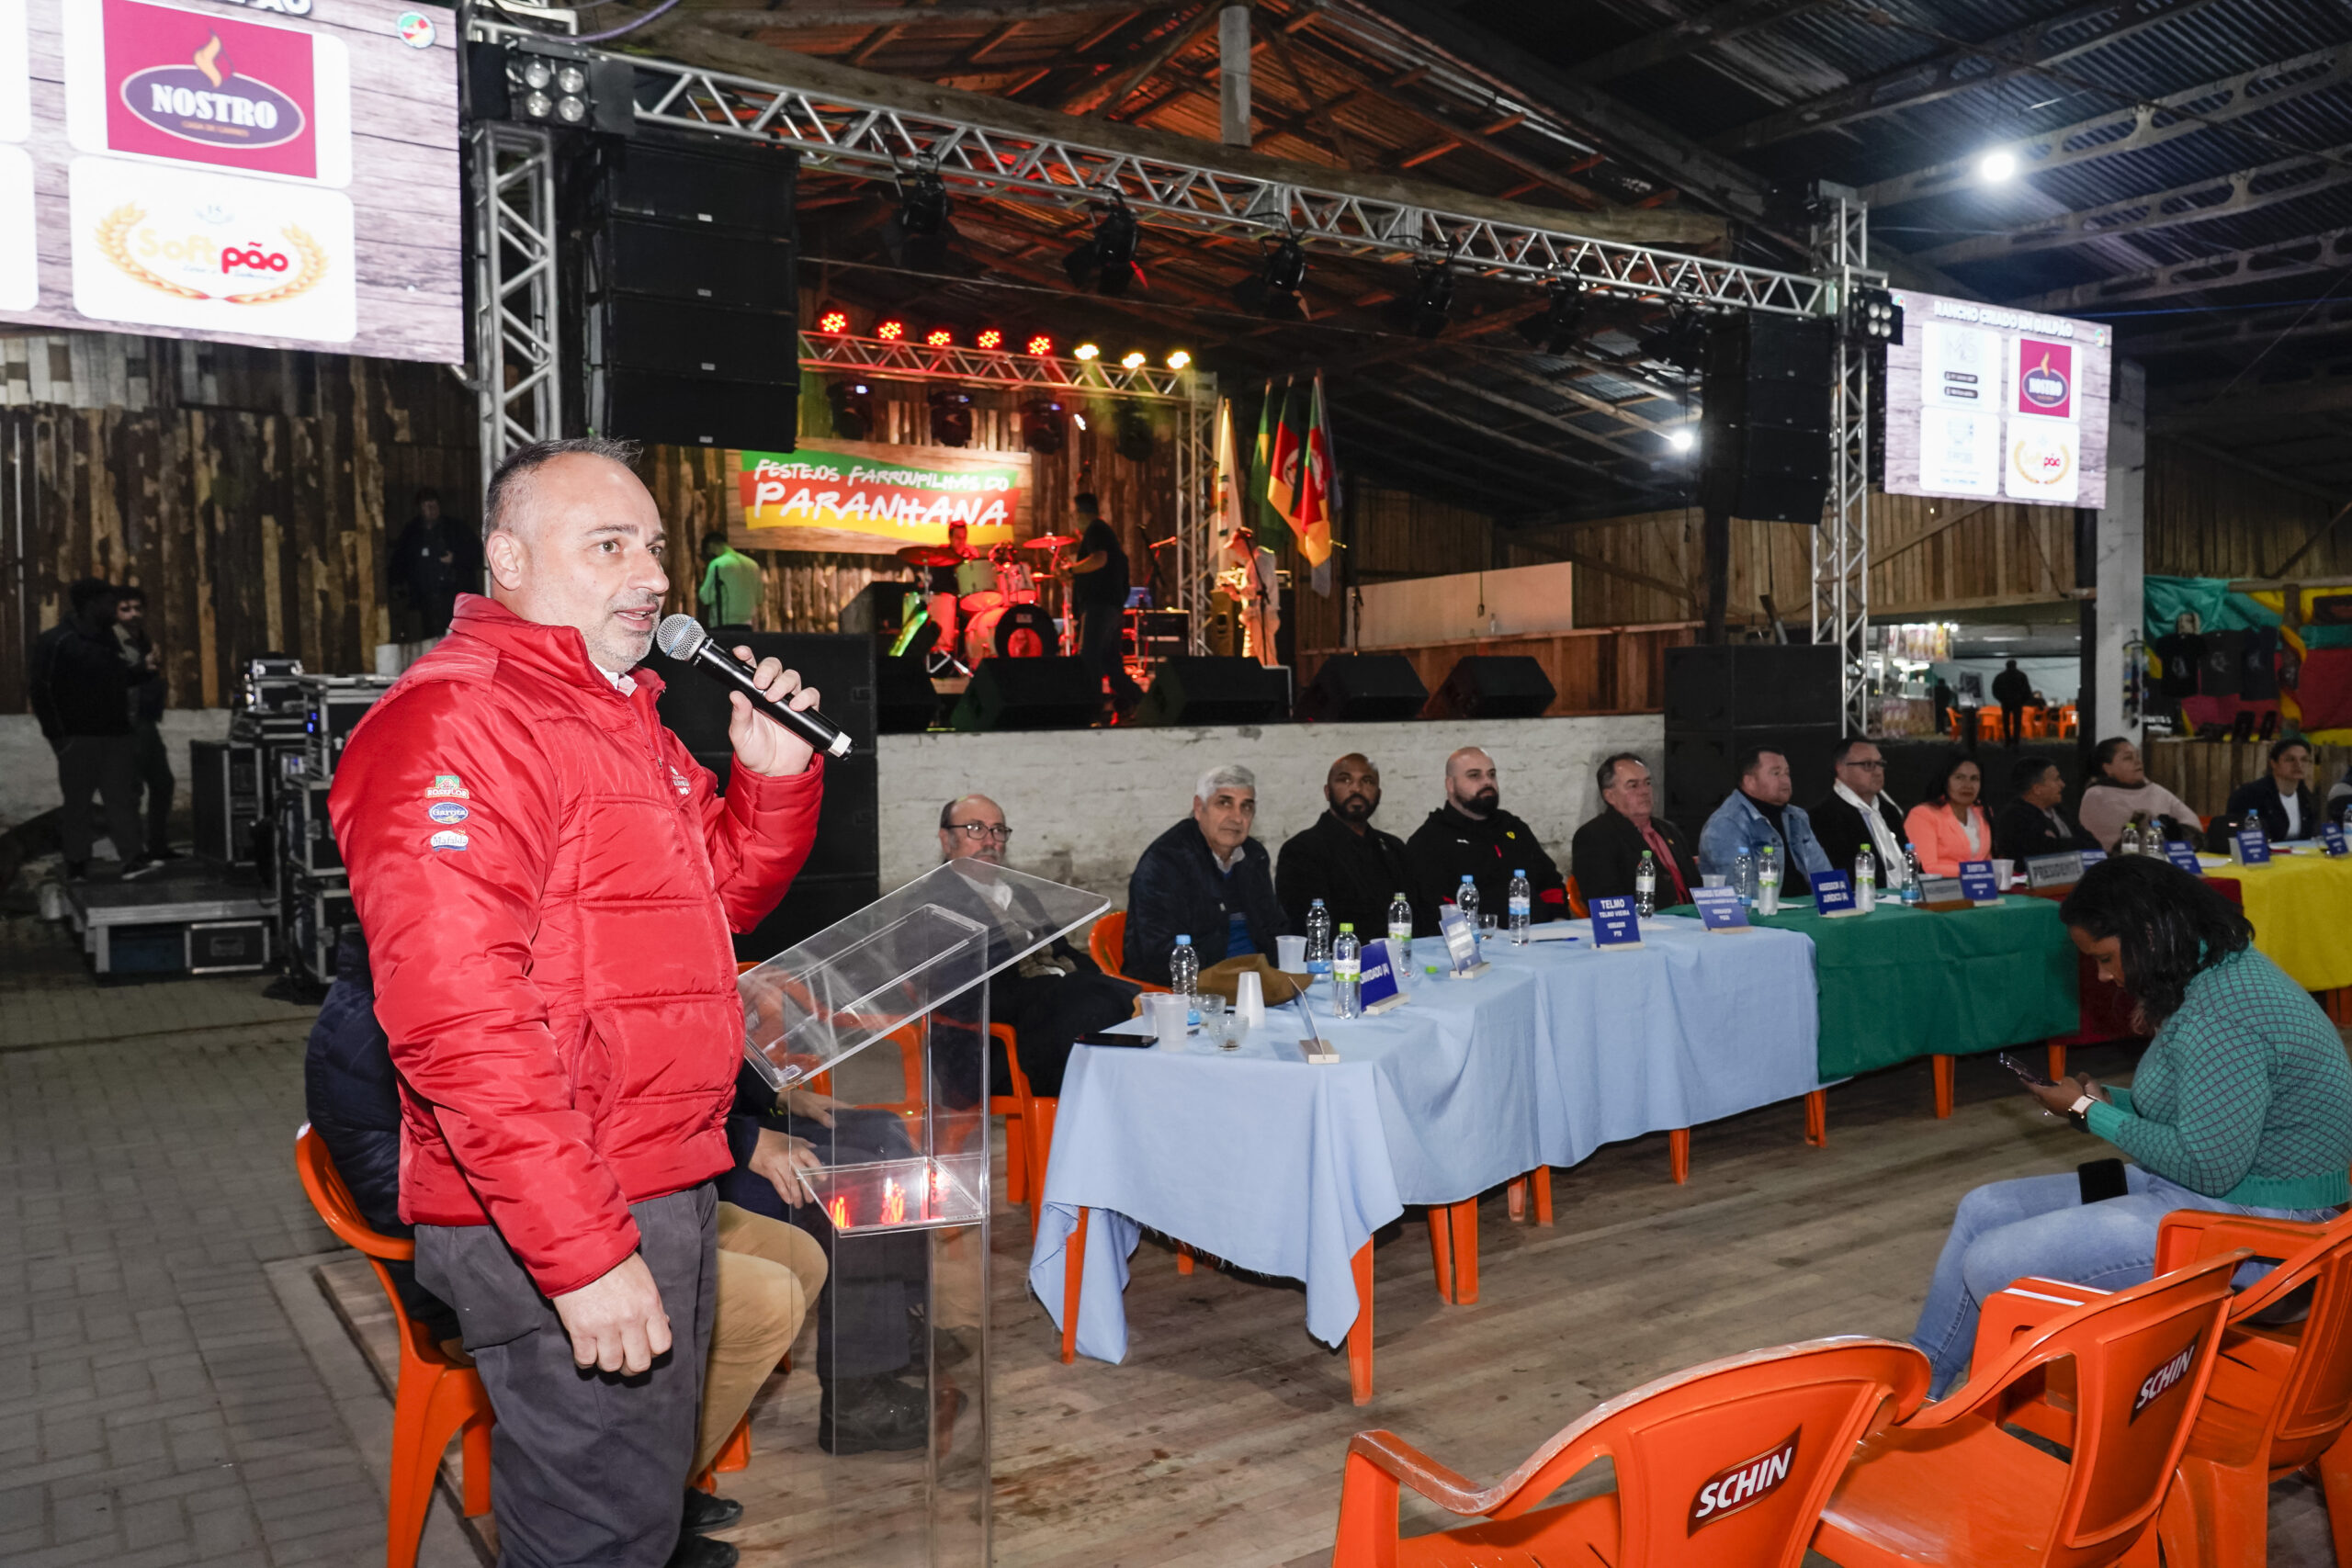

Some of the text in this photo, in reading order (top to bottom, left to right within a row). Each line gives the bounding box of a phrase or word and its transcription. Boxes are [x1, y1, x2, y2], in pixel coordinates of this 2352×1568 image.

[152, 84, 277, 130] NOSTRO
[138, 228, 218, 265] Soft
[220, 241, 288, 275] pão
[753, 459, 1010, 492] FESTEJOS FARROUPILHAS DO
[753, 482, 1009, 527] PARANHANA
[1600, 898, 1625, 910] TELMO
[2134, 1344, 2194, 1412] SCHIN
[1695, 1446, 1793, 1518] SCHIN
